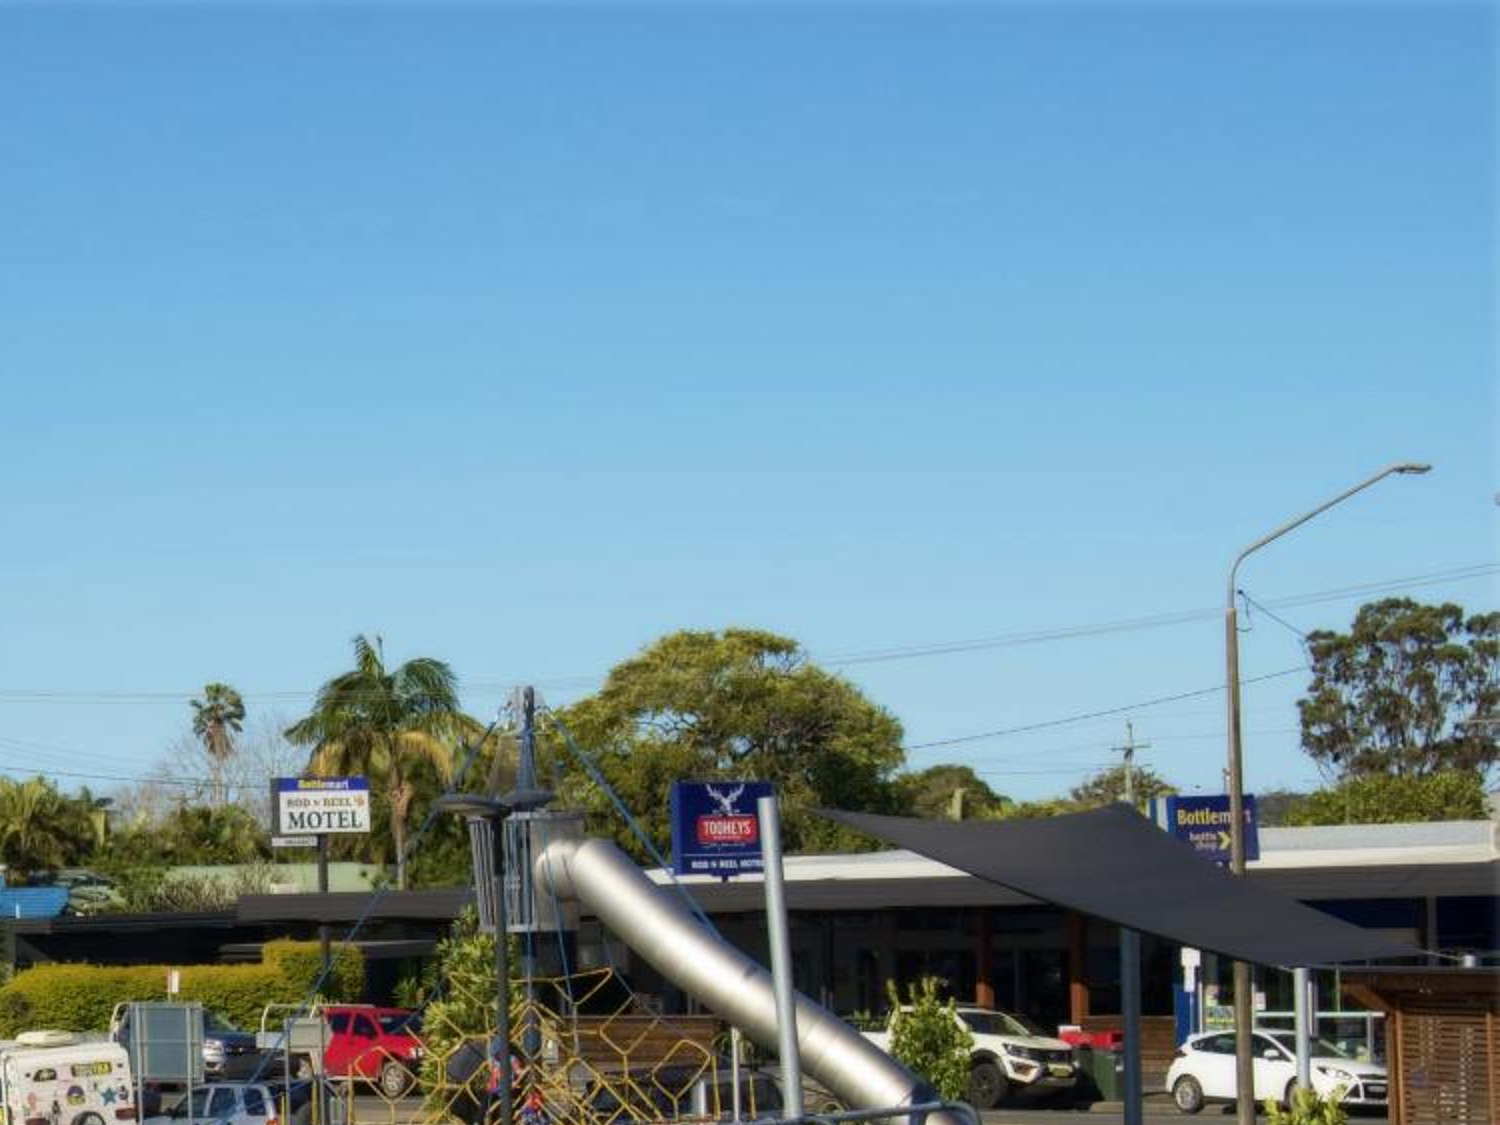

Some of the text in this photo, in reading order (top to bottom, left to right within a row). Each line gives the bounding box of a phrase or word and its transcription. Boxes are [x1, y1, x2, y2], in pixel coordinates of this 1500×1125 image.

[287, 811, 363, 830] MOTEL
[1177, 807, 1252, 826] Bottlemt
[701, 821, 751, 835] TOOHEYS
